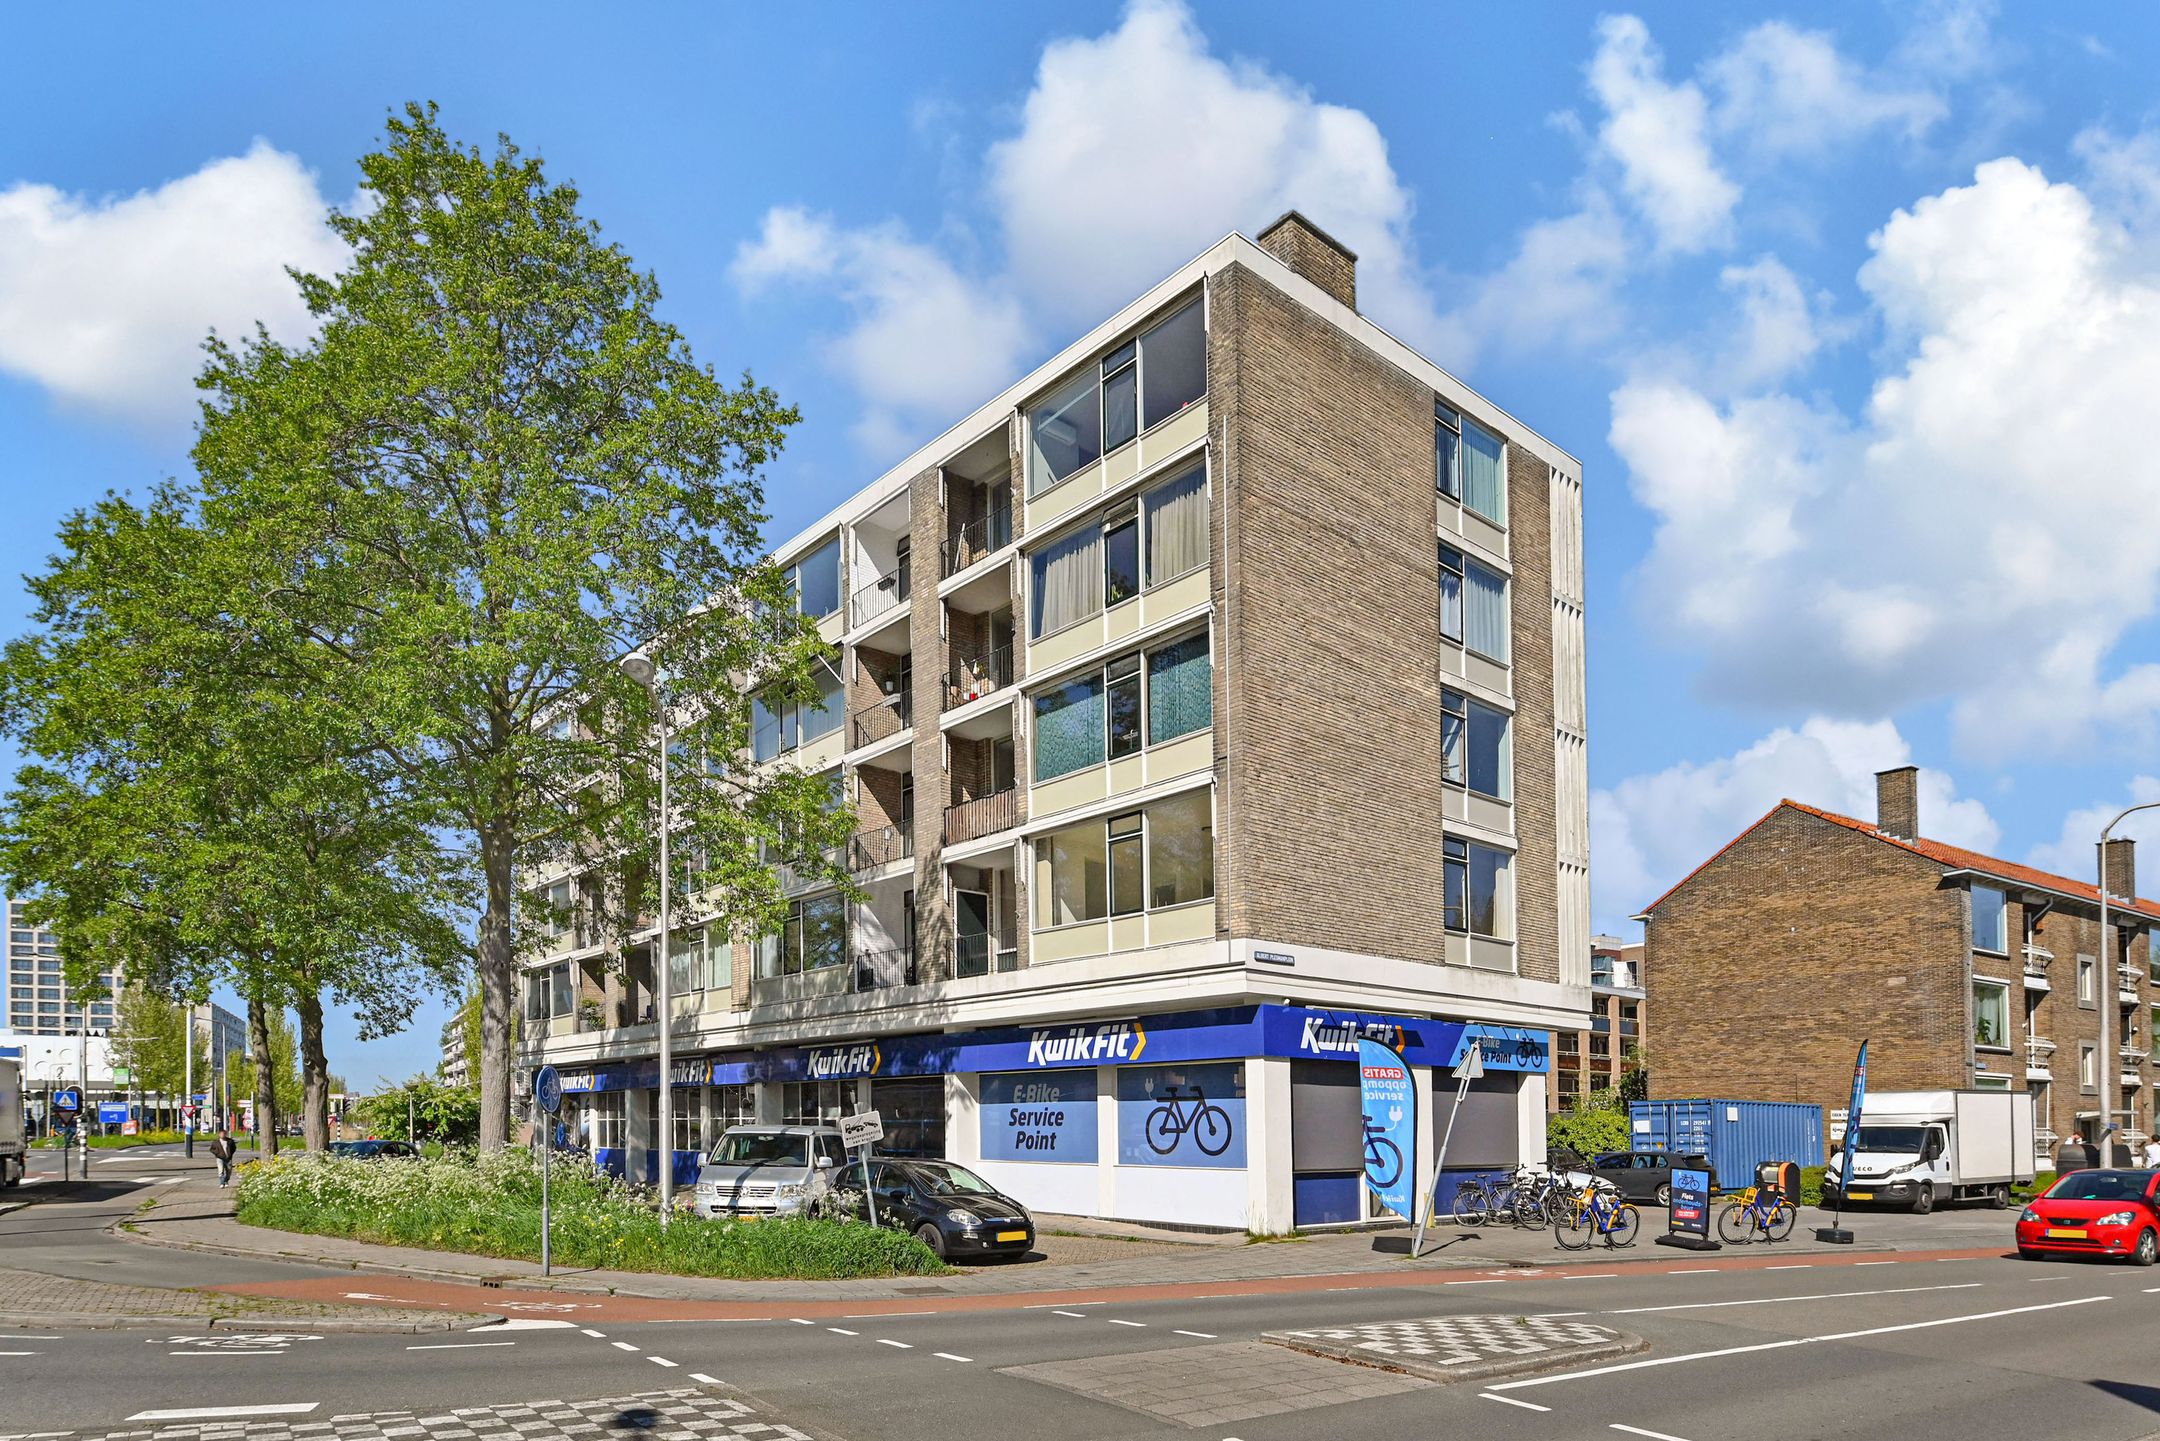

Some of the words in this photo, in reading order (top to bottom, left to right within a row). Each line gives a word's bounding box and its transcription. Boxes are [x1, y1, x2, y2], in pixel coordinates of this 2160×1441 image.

[1490, 1050, 1512, 1064] Point
[670, 1060, 706, 1083] wikFit
[1013, 1083, 1060, 1103] E-Bike
[1008, 1107, 1064, 1127] Service
[1015, 1130, 1057, 1151] Point
[1681, 1192, 1694, 1201] Fiets
